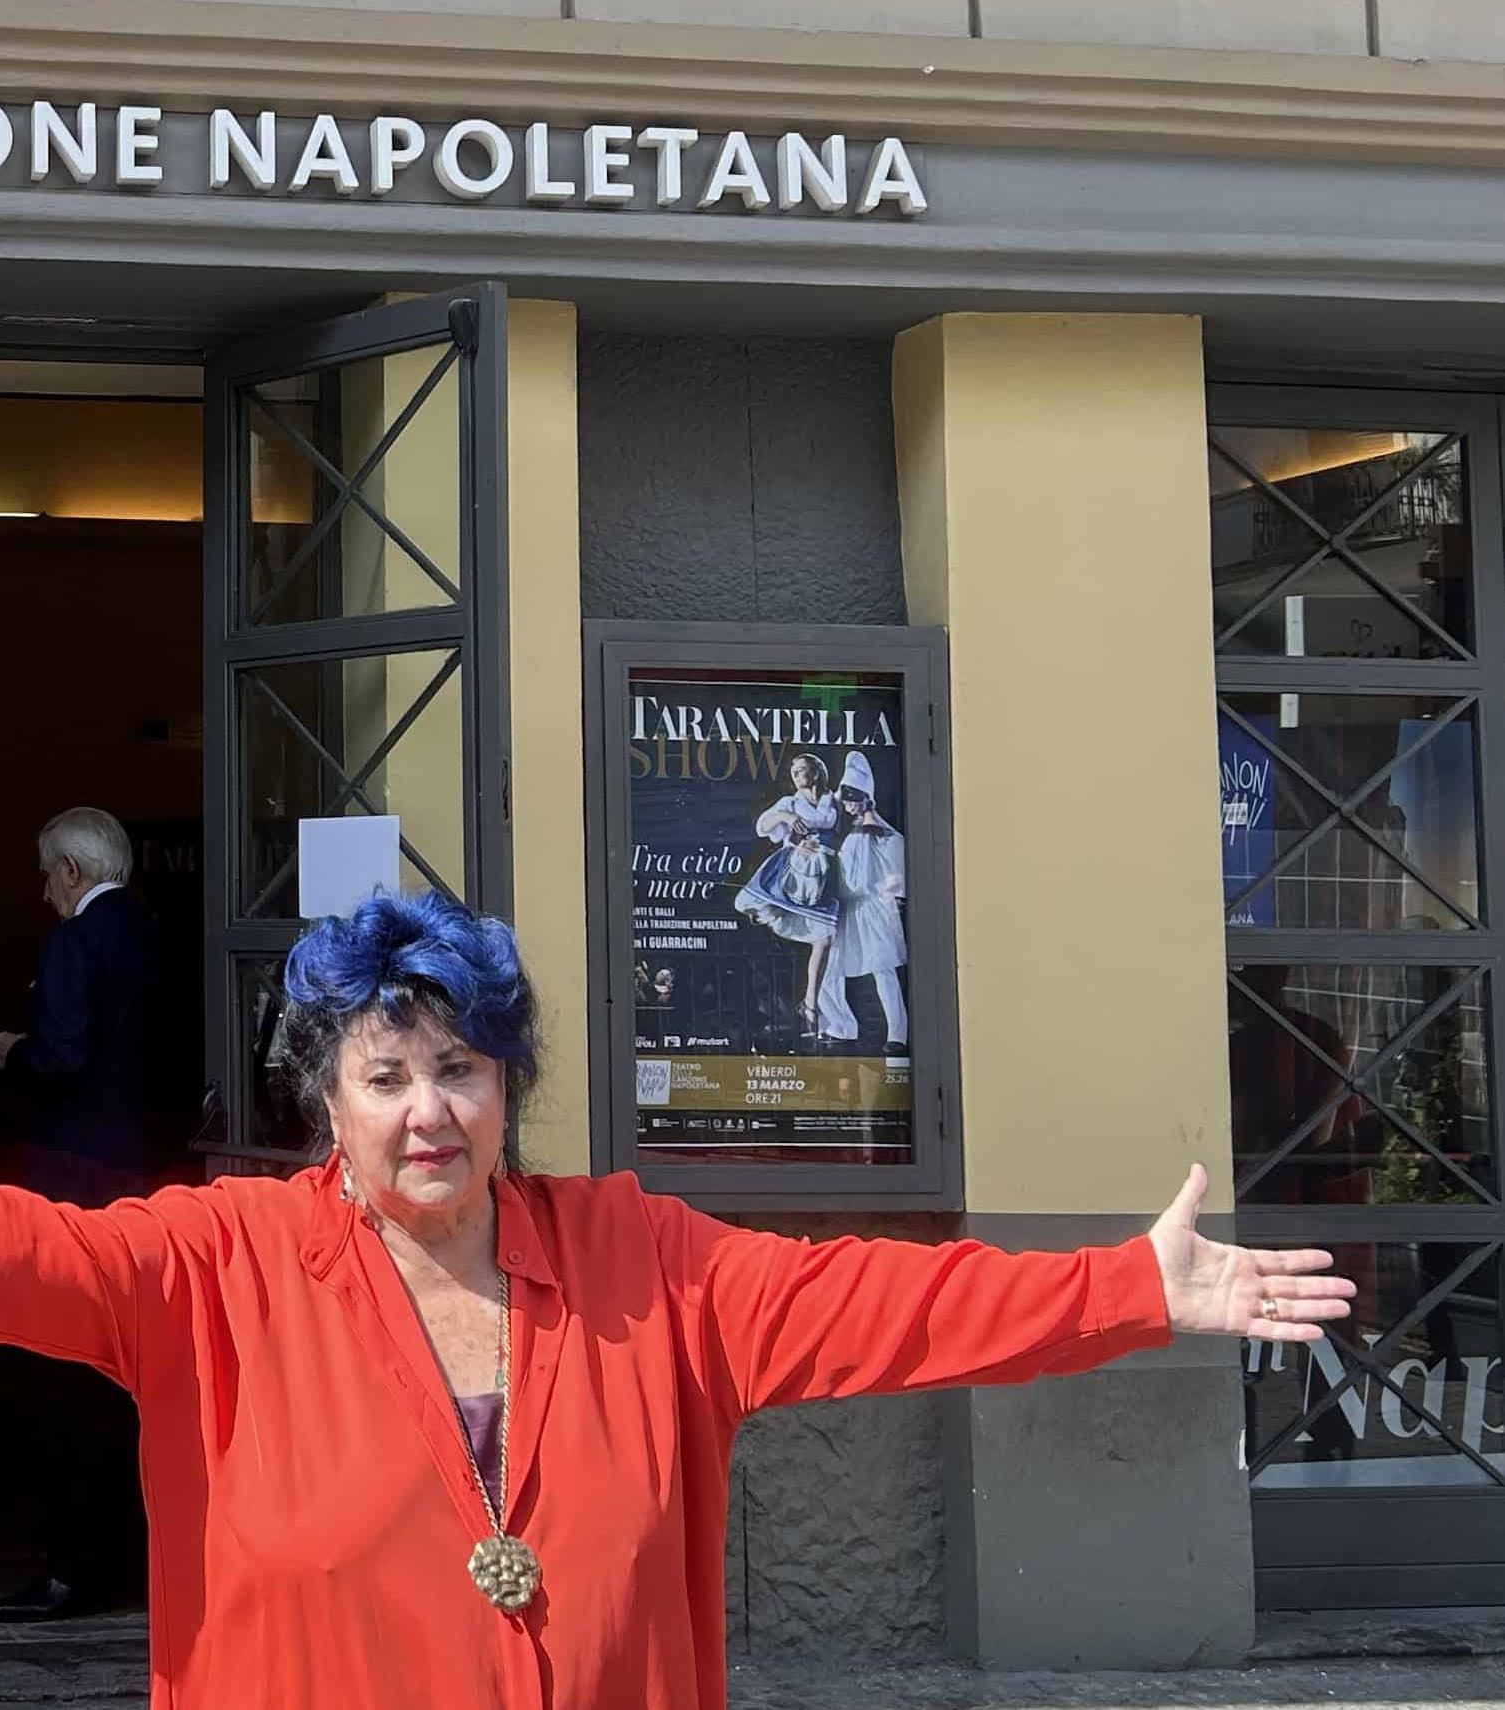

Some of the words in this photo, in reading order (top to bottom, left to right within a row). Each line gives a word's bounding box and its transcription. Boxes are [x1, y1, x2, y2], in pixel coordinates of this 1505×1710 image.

[208, 108, 929, 217] NAPOLETANA
[631, 696, 896, 746] TARANTELLA
[631, 736, 790, 781] SHOW
[631, 844, 671, 873] Tra
[681, 846, 742, 874] cielo
[647, 878, 714, 900] mare
[648, 936, 708, 950] GUARRACINI
[759, 1080, 806, 1091] MARZO
